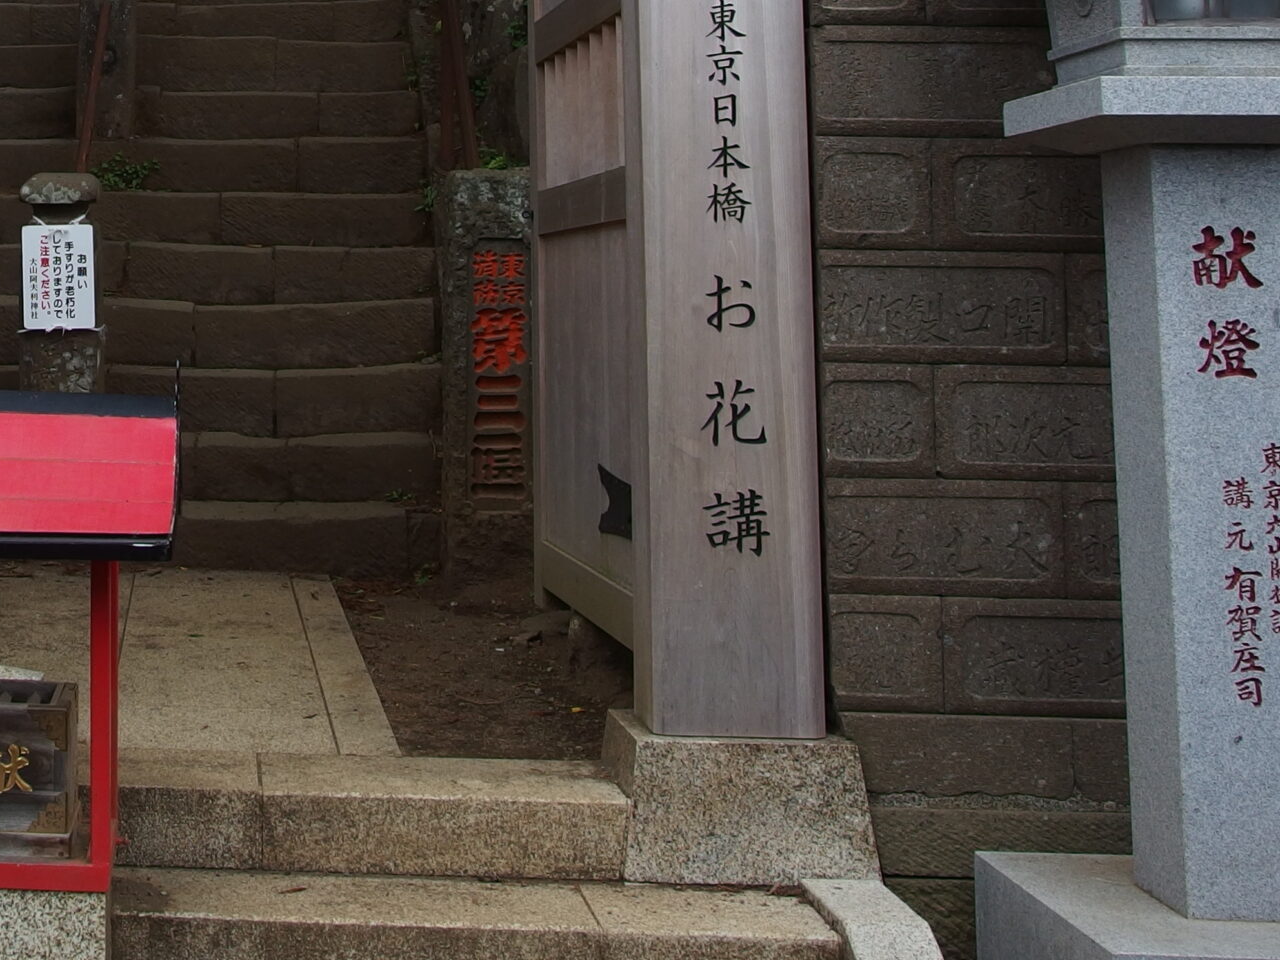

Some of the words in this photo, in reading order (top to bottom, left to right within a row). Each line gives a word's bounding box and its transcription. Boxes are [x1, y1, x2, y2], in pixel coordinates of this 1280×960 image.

[39, 234, 52, 317] ご注意ください。
[64, 241, 76, 319] 手すりが老朽化
[76, 253, 88, 290] お願い
[700, 273, 771, 557] お花講
